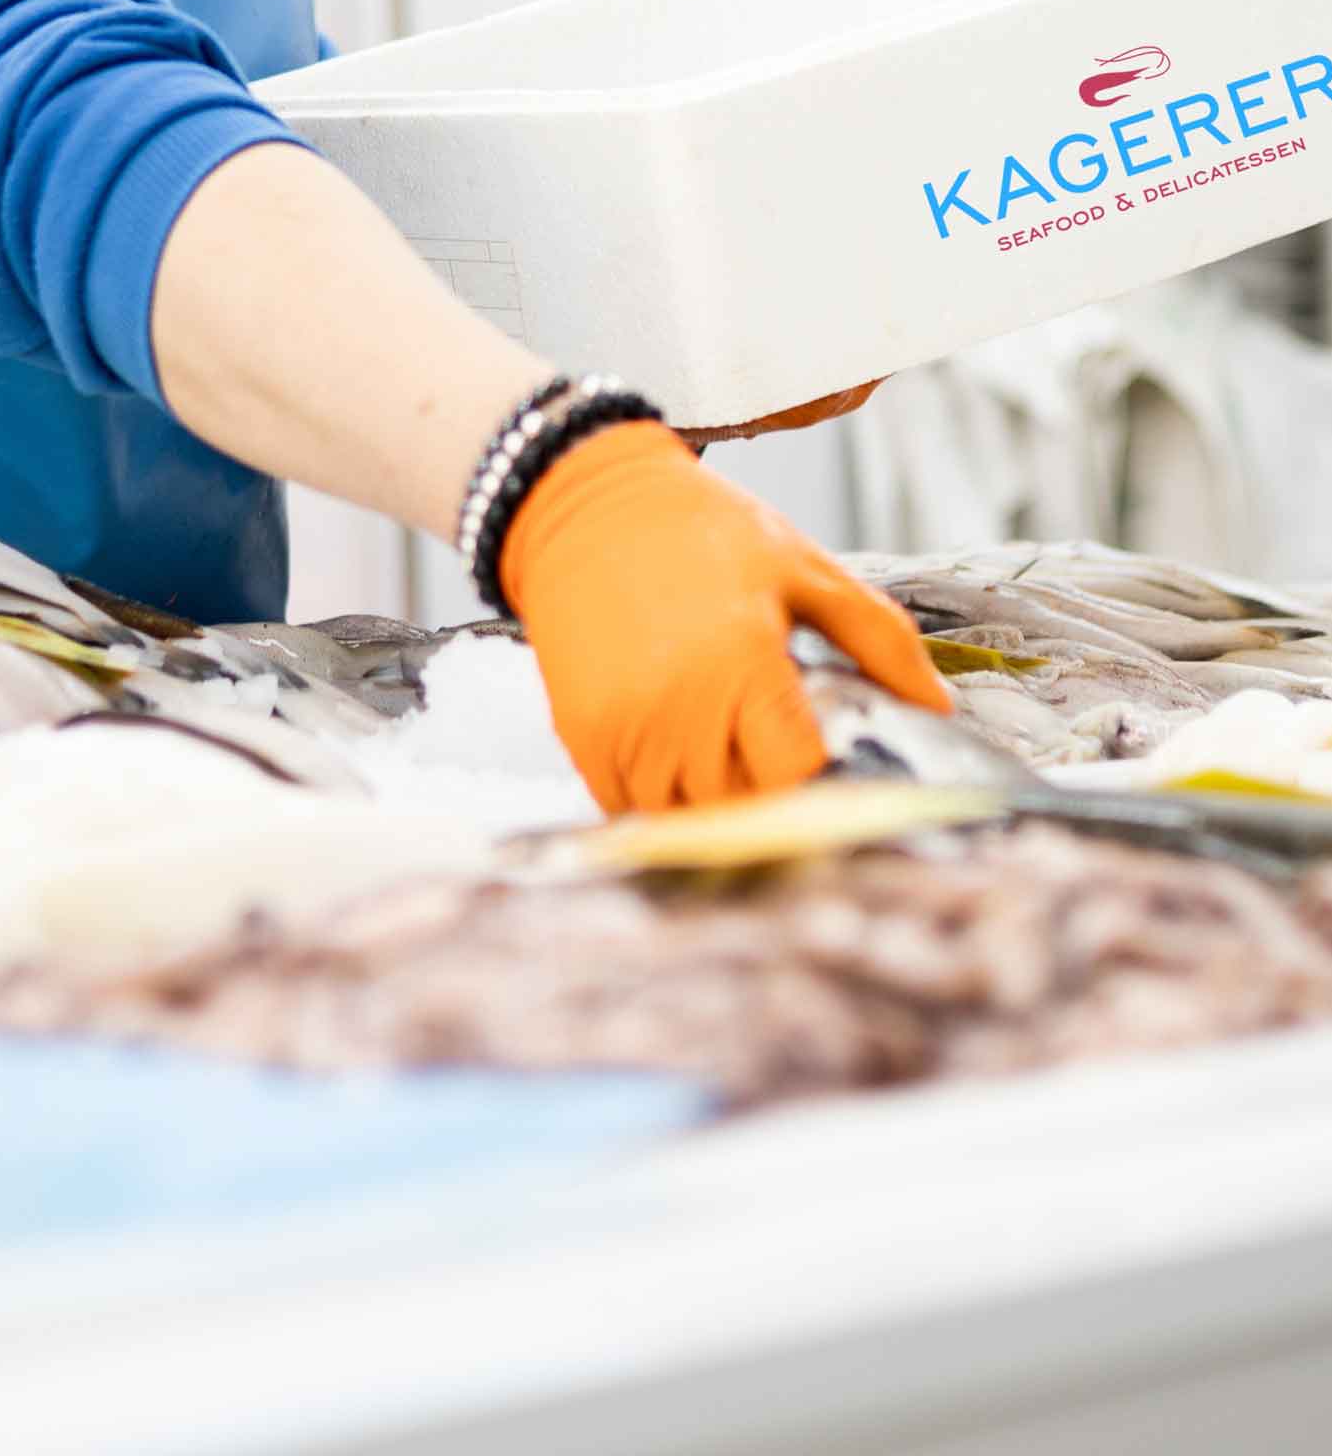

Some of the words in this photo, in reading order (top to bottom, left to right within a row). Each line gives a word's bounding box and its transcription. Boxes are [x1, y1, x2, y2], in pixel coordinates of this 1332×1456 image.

[997, 206, 1105, 252] SEAFOOD
[1115, 193, 1135, 213] &
[1143, 137, 1306, 204] DELICATESSEN
